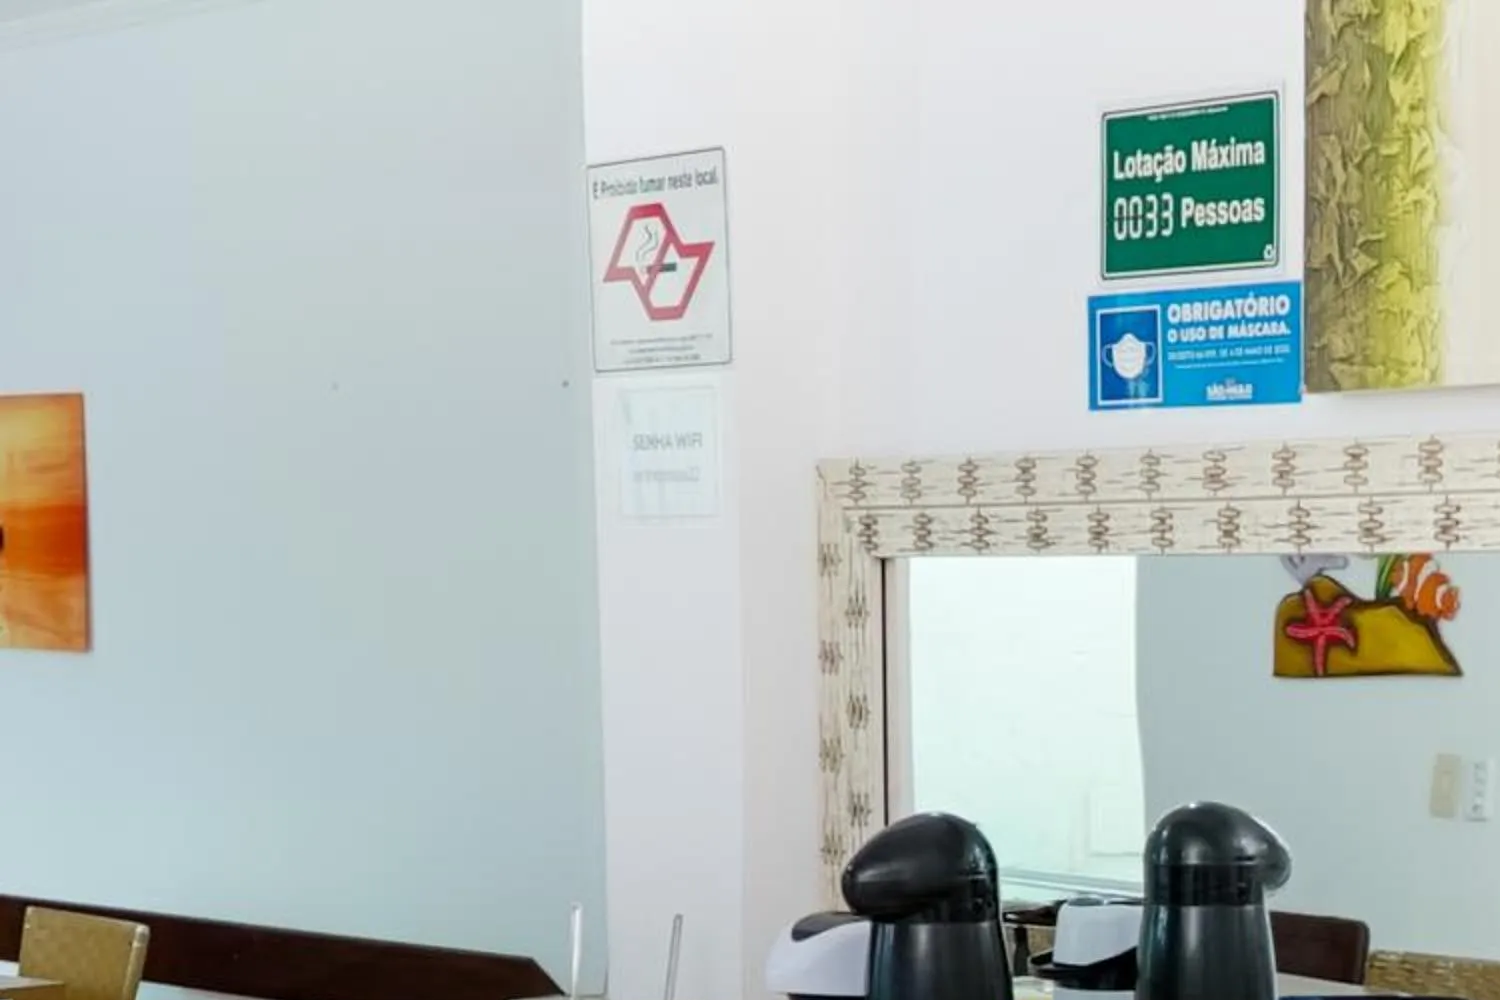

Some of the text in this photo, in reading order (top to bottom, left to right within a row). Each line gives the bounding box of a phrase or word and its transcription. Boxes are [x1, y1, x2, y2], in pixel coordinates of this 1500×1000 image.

[1113, 136, 1265, 182] Lotação Máxima
[1113, 192, 1265, 240] 0033 Pessoas
[1167, 290, 1290, 323] OBRIGATÓRIO
[1167, 319, 1291, 343] O USO DE MÁSCARA.
[633, 431, 673, 450] SENHA
